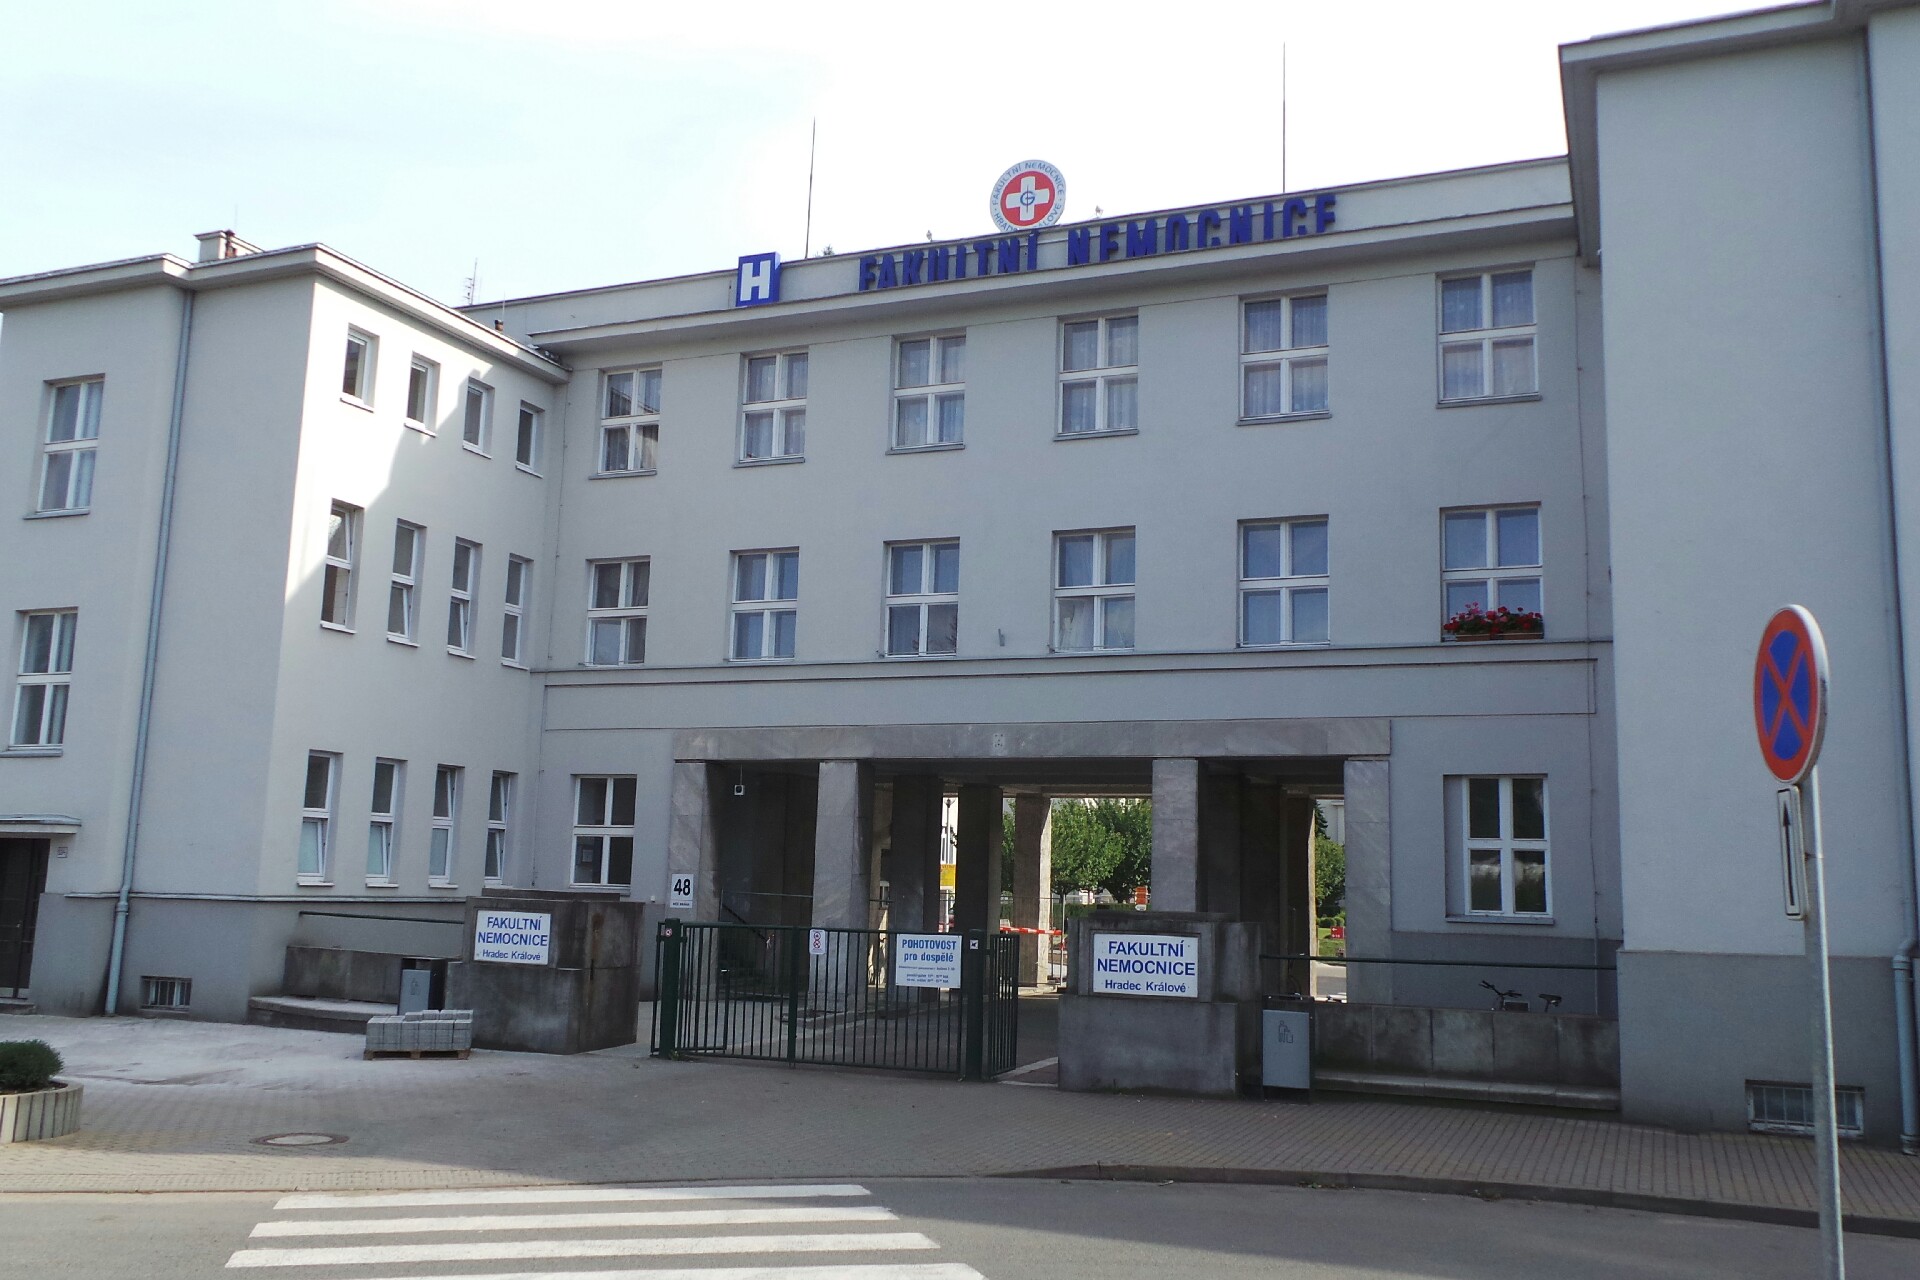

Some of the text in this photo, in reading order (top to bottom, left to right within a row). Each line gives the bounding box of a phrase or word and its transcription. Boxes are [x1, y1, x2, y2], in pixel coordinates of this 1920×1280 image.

[992, 162, 1065, 206] FAKULTNÍ NEMOCNICE
[1067, 194, 1336, 266] NEMOCNICE
[740, 260, 771, 301] H
[674, 878, 691, 896] 48
[486, 915, 543, 931] FAKULTNÍ
[477, 931, 549, 947] NEMOCNICE
[901, 939, 957, 951] POHOTOVOST
[482, 949, 541, 961] Hradec Králové
[1108, 939, 1185, 958] FAKULTNÍ
[904, 952, 954, 964] pro dospělé
[1097, 958, 1196, 976] NEMOCNICE
[1105, 979, 1187, 993] Hradec Králové
